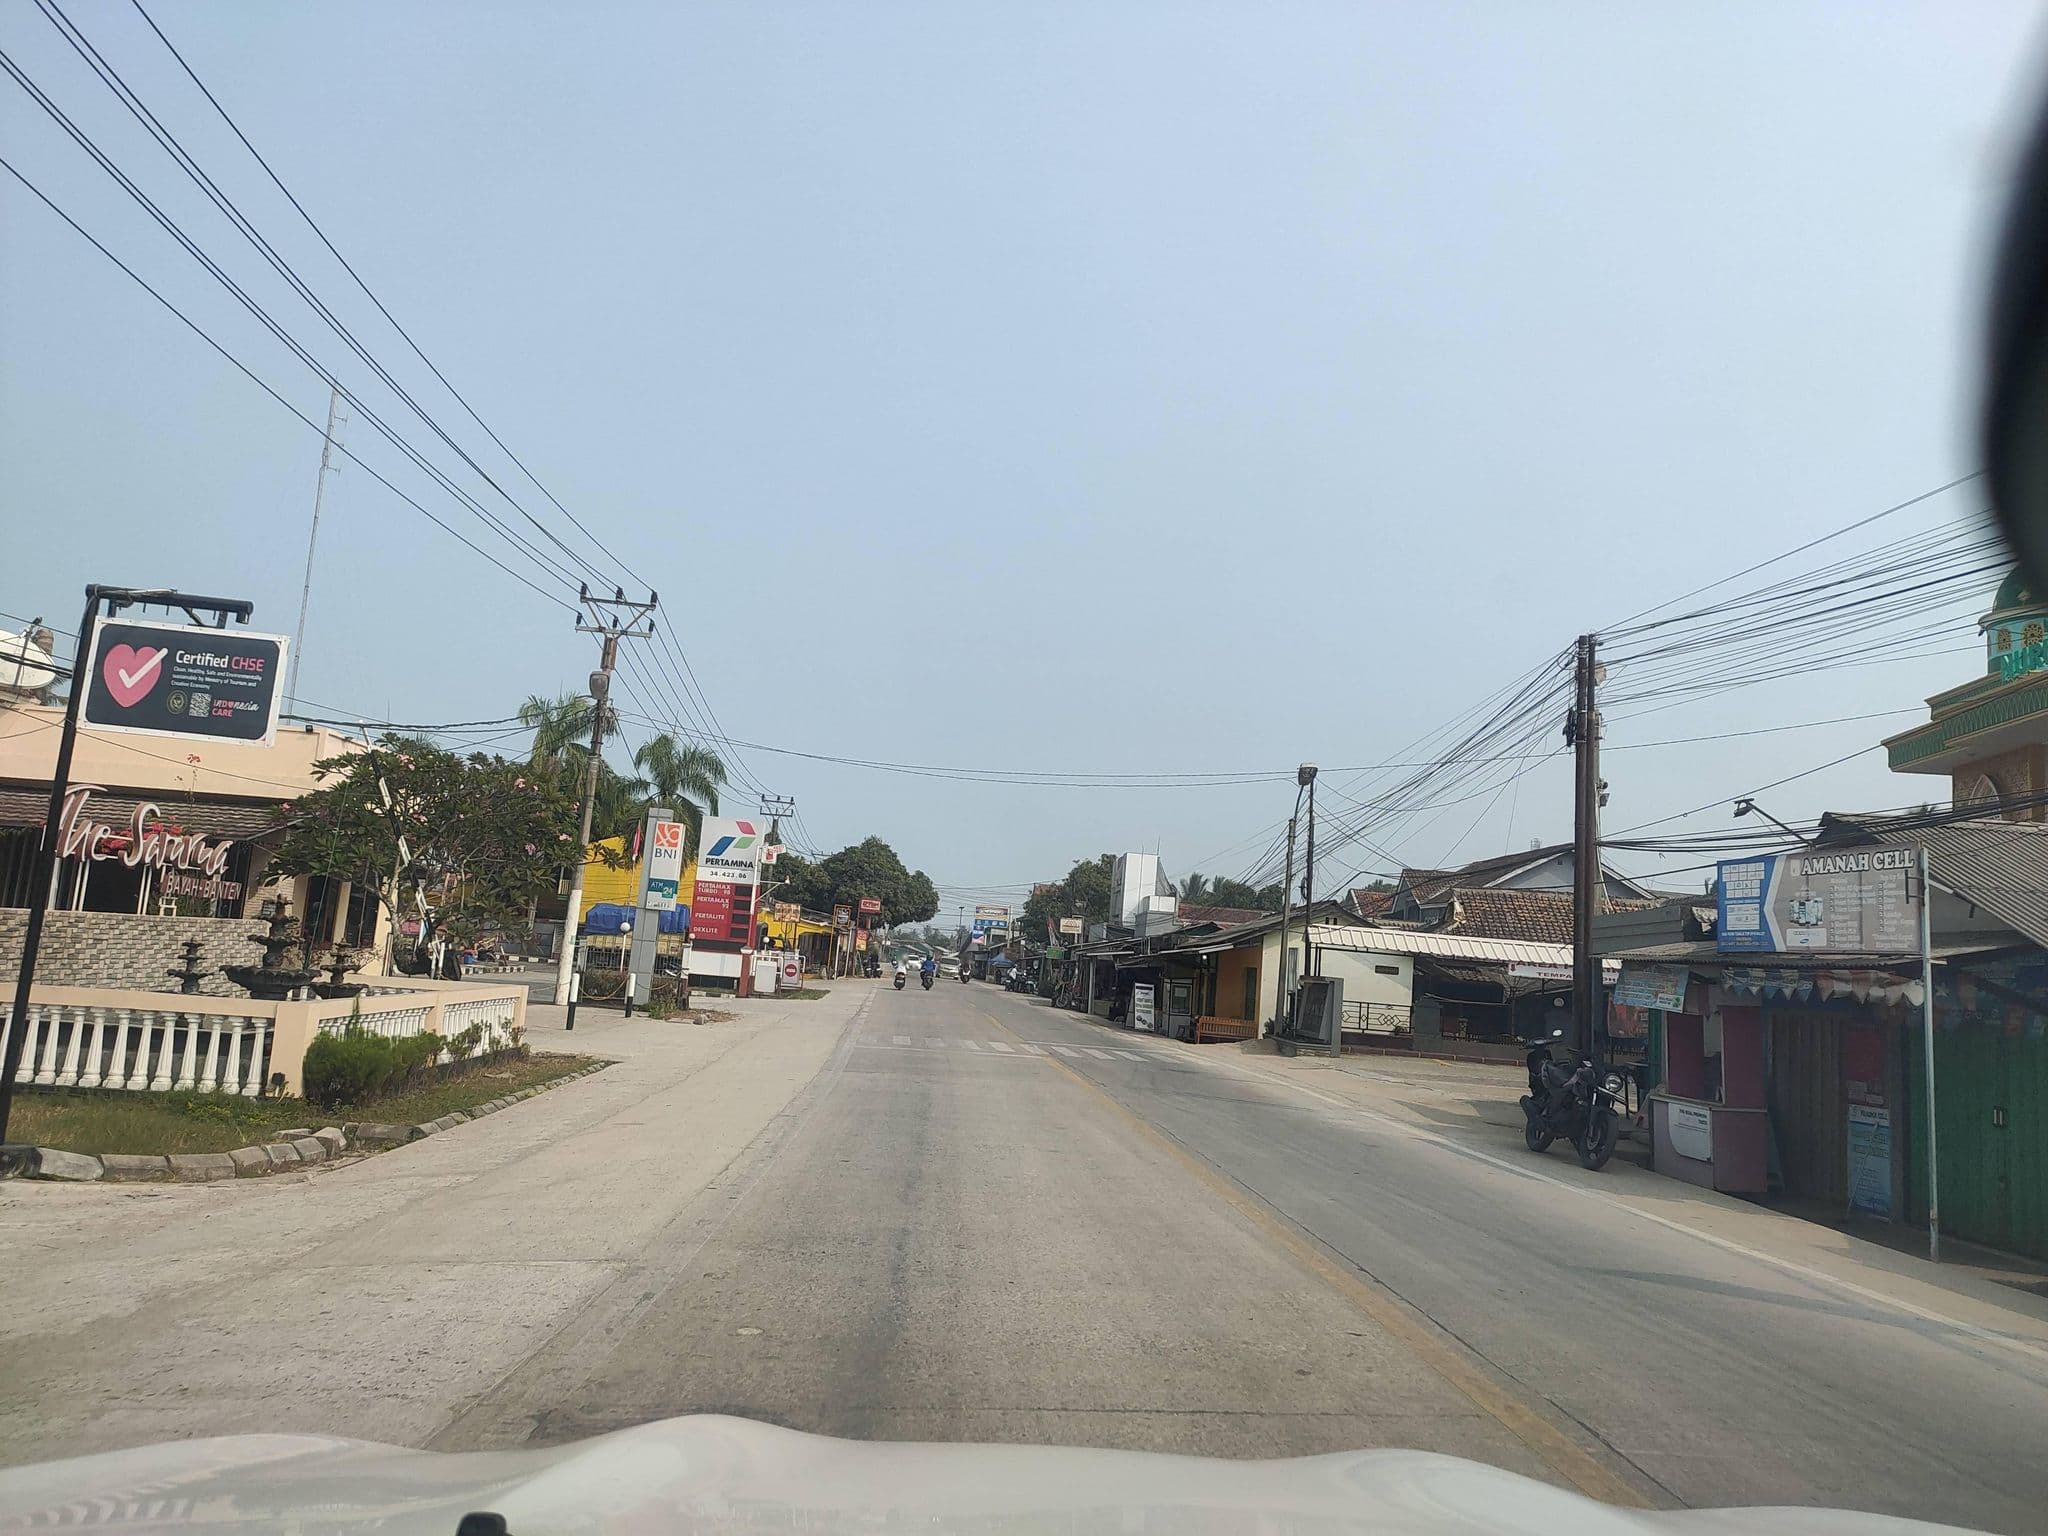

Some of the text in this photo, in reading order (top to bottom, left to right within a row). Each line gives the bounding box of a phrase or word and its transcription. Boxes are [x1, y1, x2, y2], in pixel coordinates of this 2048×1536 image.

[176, 650, 265, 672] Certified CHSE
[212, 708, 233, 717] CARE
[654, 848, 677, 859] BNI
[705, 857, 754, 868] PERTAMINA
[1801, 849, 1914, 875] AMANAH CELL
[650, 881, 664, 889] ATM
[698, 882, 731, 890] PERTAMAX
[695, 912, 725, 920] PERTALITE
[693, 926, 718, 934] DEXLITE
